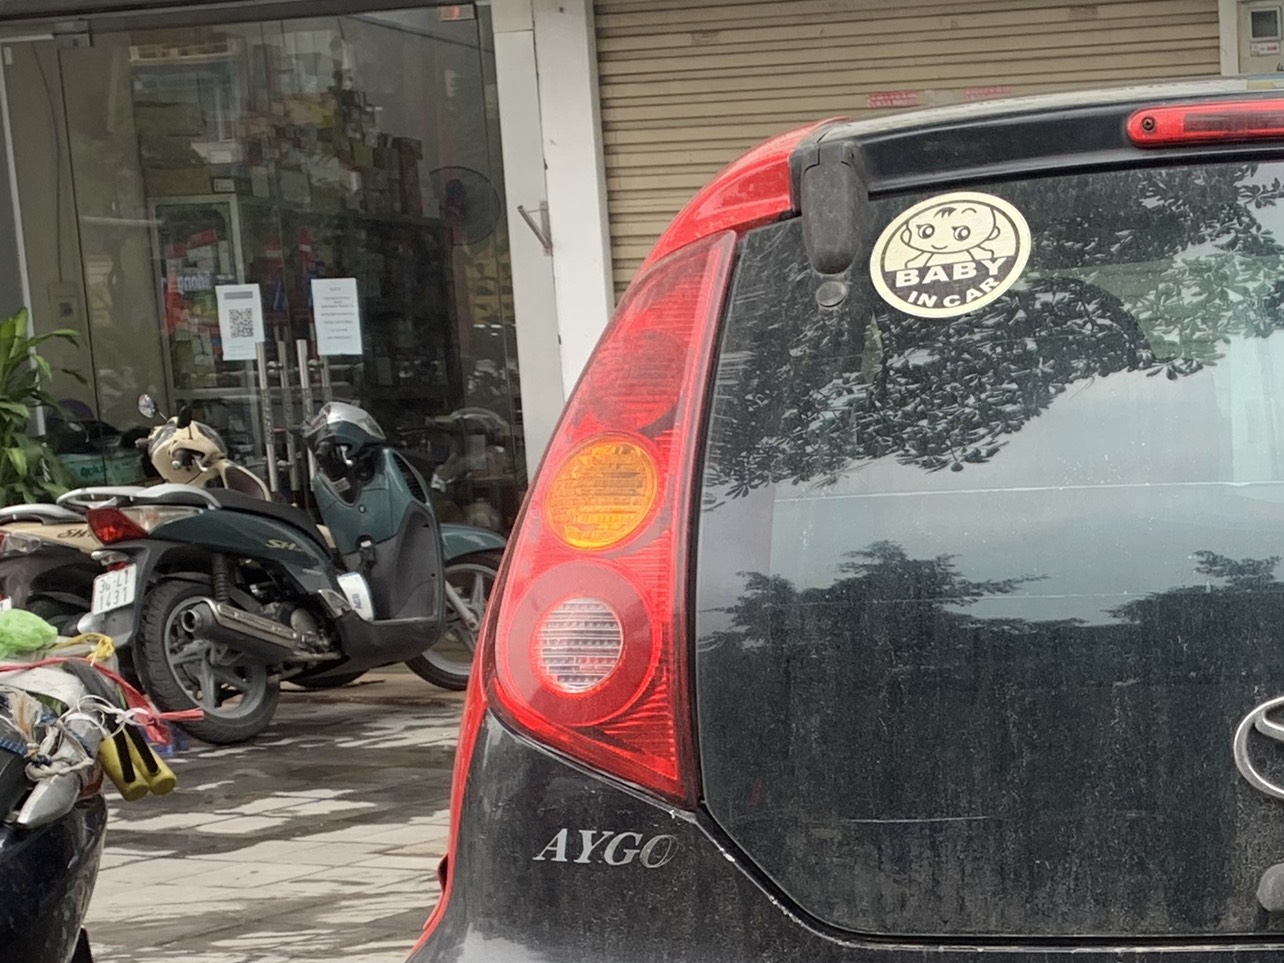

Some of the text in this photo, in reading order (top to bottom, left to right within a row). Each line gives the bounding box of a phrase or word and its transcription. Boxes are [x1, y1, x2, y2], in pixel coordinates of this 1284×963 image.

[896, 258, 1007, 287] BABY
[908, 276, 1002, 308] IN CAR
[532, 828, 678, 869] AYGO
